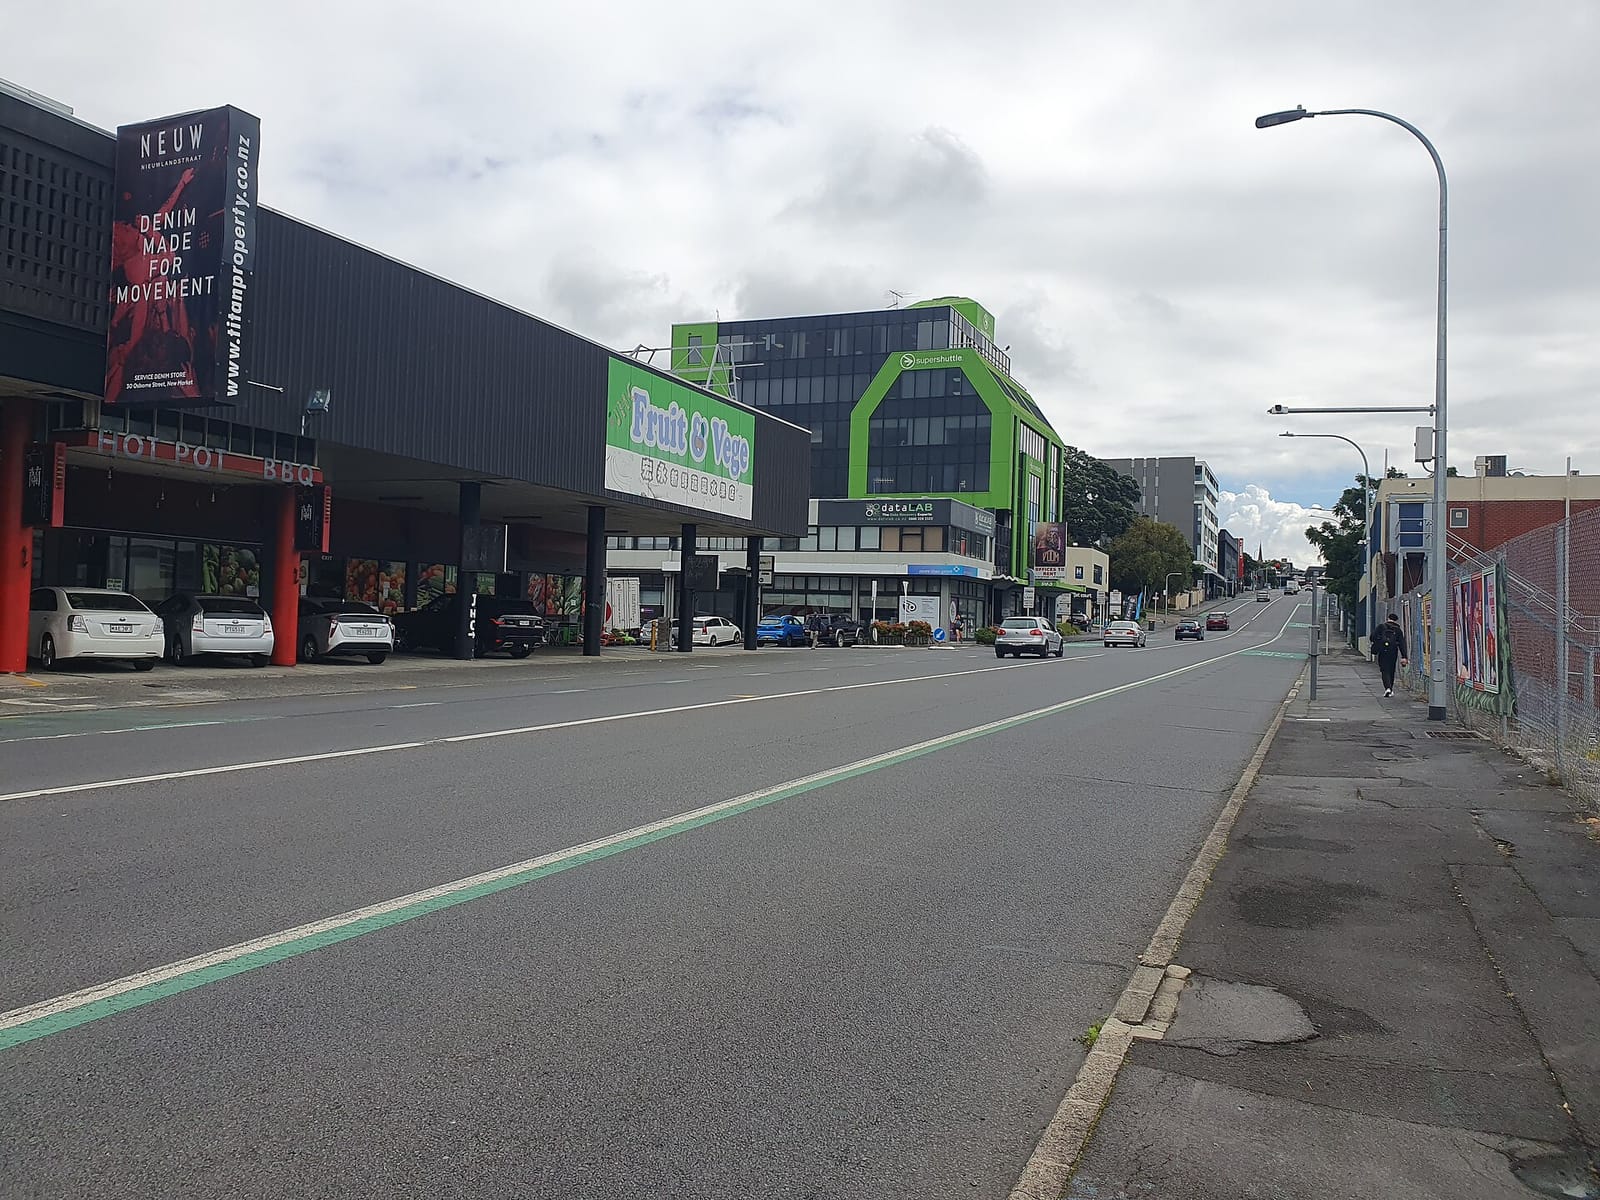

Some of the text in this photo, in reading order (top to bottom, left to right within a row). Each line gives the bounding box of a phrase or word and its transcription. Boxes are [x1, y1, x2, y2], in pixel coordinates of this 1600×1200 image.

[141, 123, 203, 158] NEUW
[140, 207, 196, 233] DENIM
[143, 231, 192, 256] MADE
[149, 256, 183, 278] FOR
[226, 134, 250, 397] www.titanproperty.co.nz
[116, 275, 215, 305] MOVEMENT
[916, 354, 962, 364] supershuttle
[631, 388, 688, 455] Fruit
[711, 417, 749, 480] Vege
[97, 429, 314, 488] HOT POT BBQ
[881, 503, 933, 512] dataLAB
